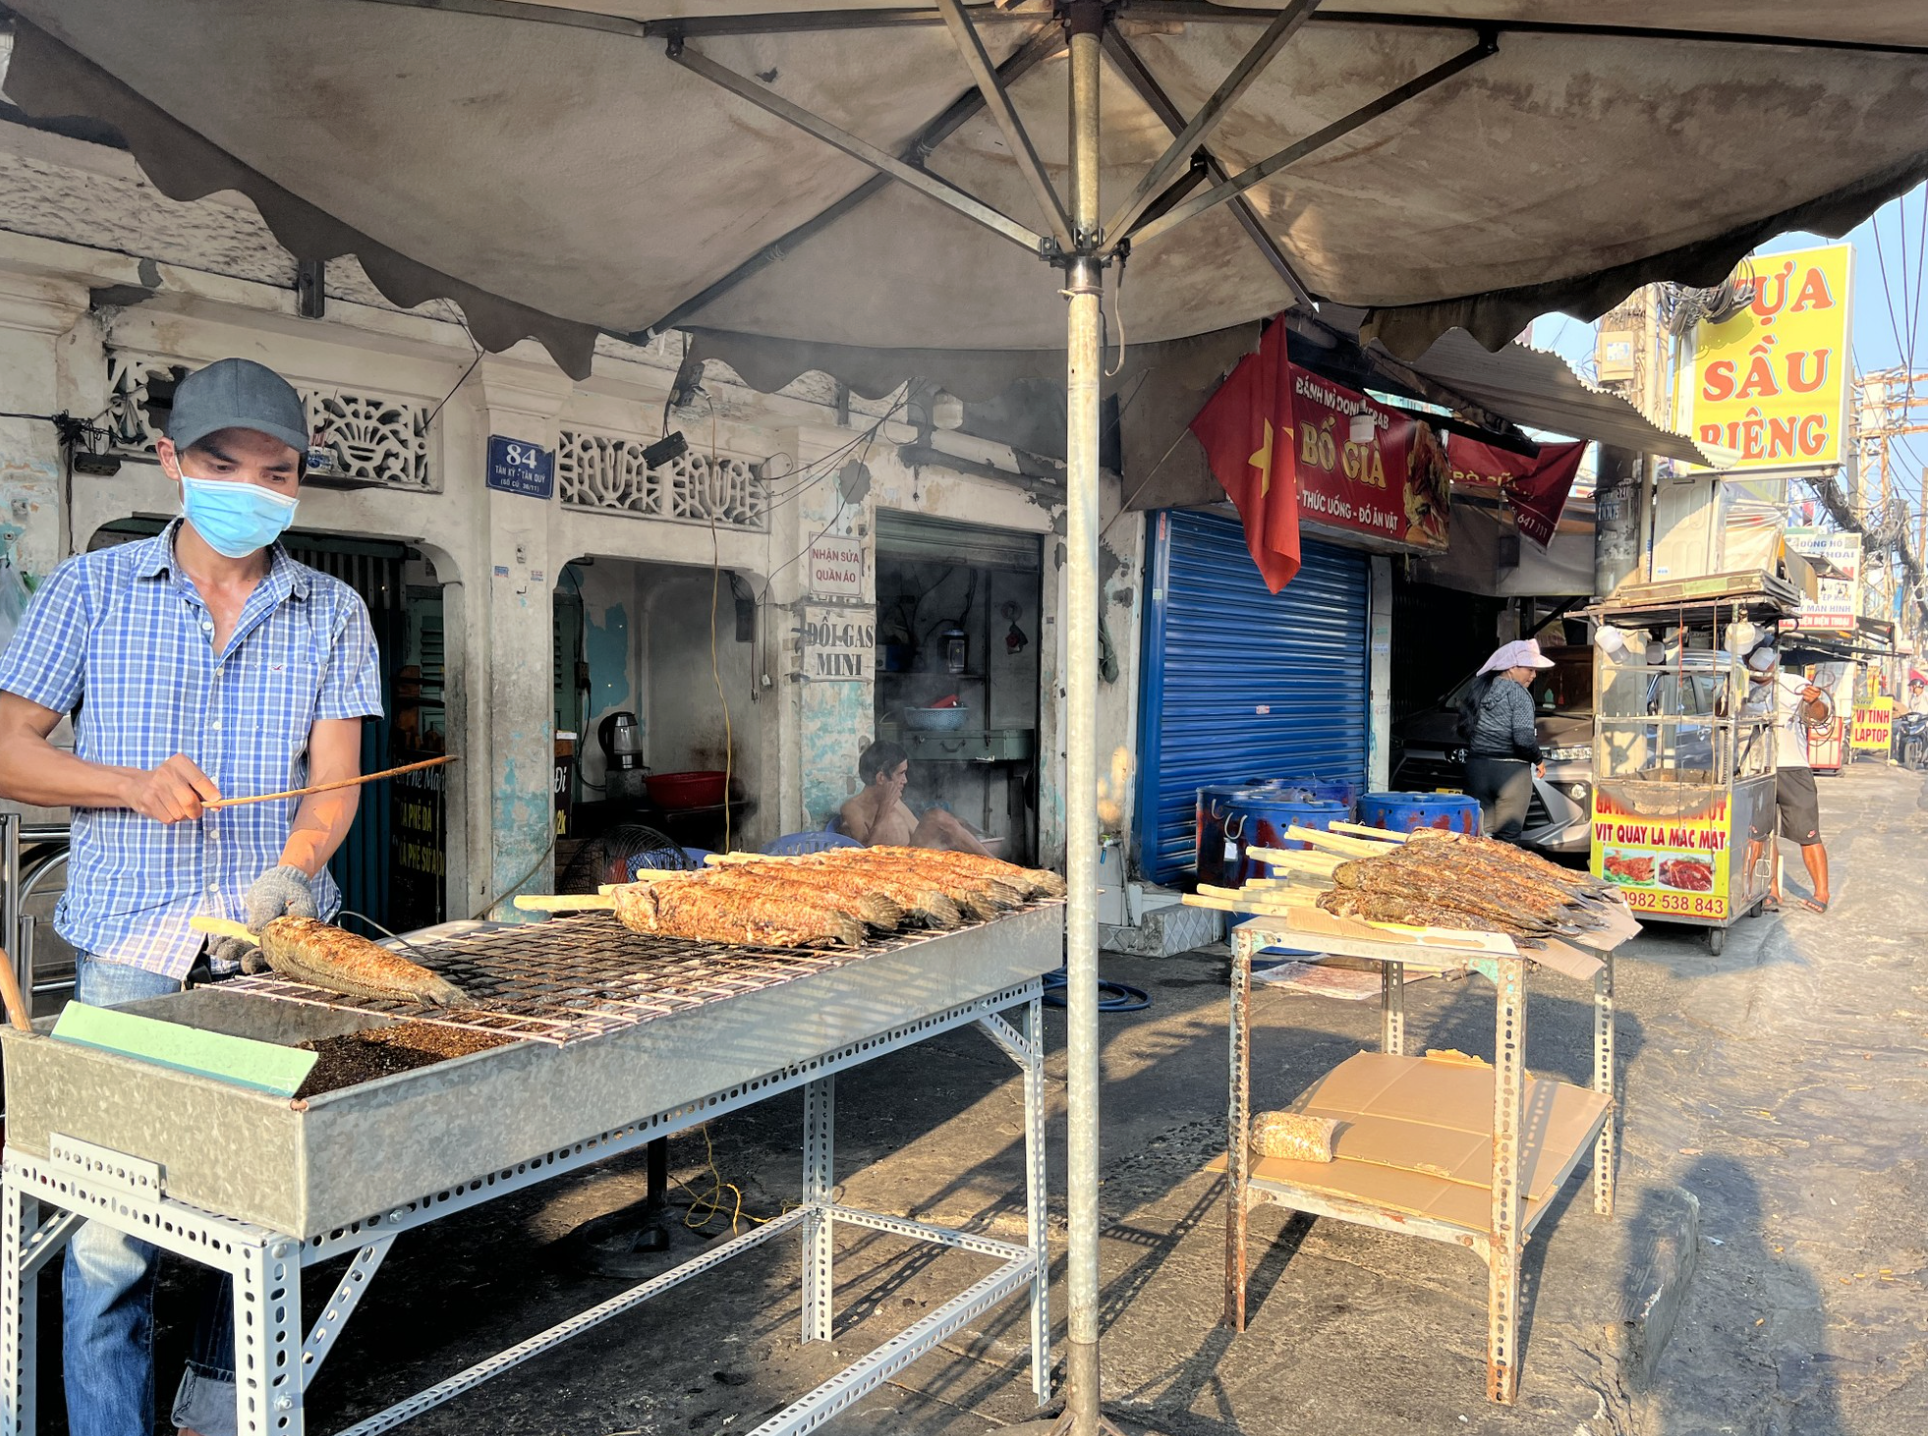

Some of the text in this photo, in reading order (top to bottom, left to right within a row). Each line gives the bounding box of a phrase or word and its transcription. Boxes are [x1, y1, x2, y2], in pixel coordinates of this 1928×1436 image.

[1736, 261, 1834, 326] ỰA
[1702, 335, 1830, 402] SẦU
[1295, 375, 1324, 401] BÁNH
[1300, 414, 1336, 472] BỐ
[506, 444, 537, 469] 84
[1302, 489, 1326, 512] THỨC
[1327, 494, 1352, 519] UỐNG
[1517, 513, 1535, 529] 641
[812, 548, 860, 563] NHẬN SỬA
[815, 566, 856, 583] QUẦN ÁO
[816, 653, 862, 676] MINI
[1855, 706, 1890, 724] VI TÍNH
[1855, 728, 1889, 742] LAPTOP
[1595, 823, 1613, 846] VỊT
[1616, 824, 1648, 845] QUAY
[1661, 895, 1689, 910] 538
[1695, 898, 1724, 914] 843
